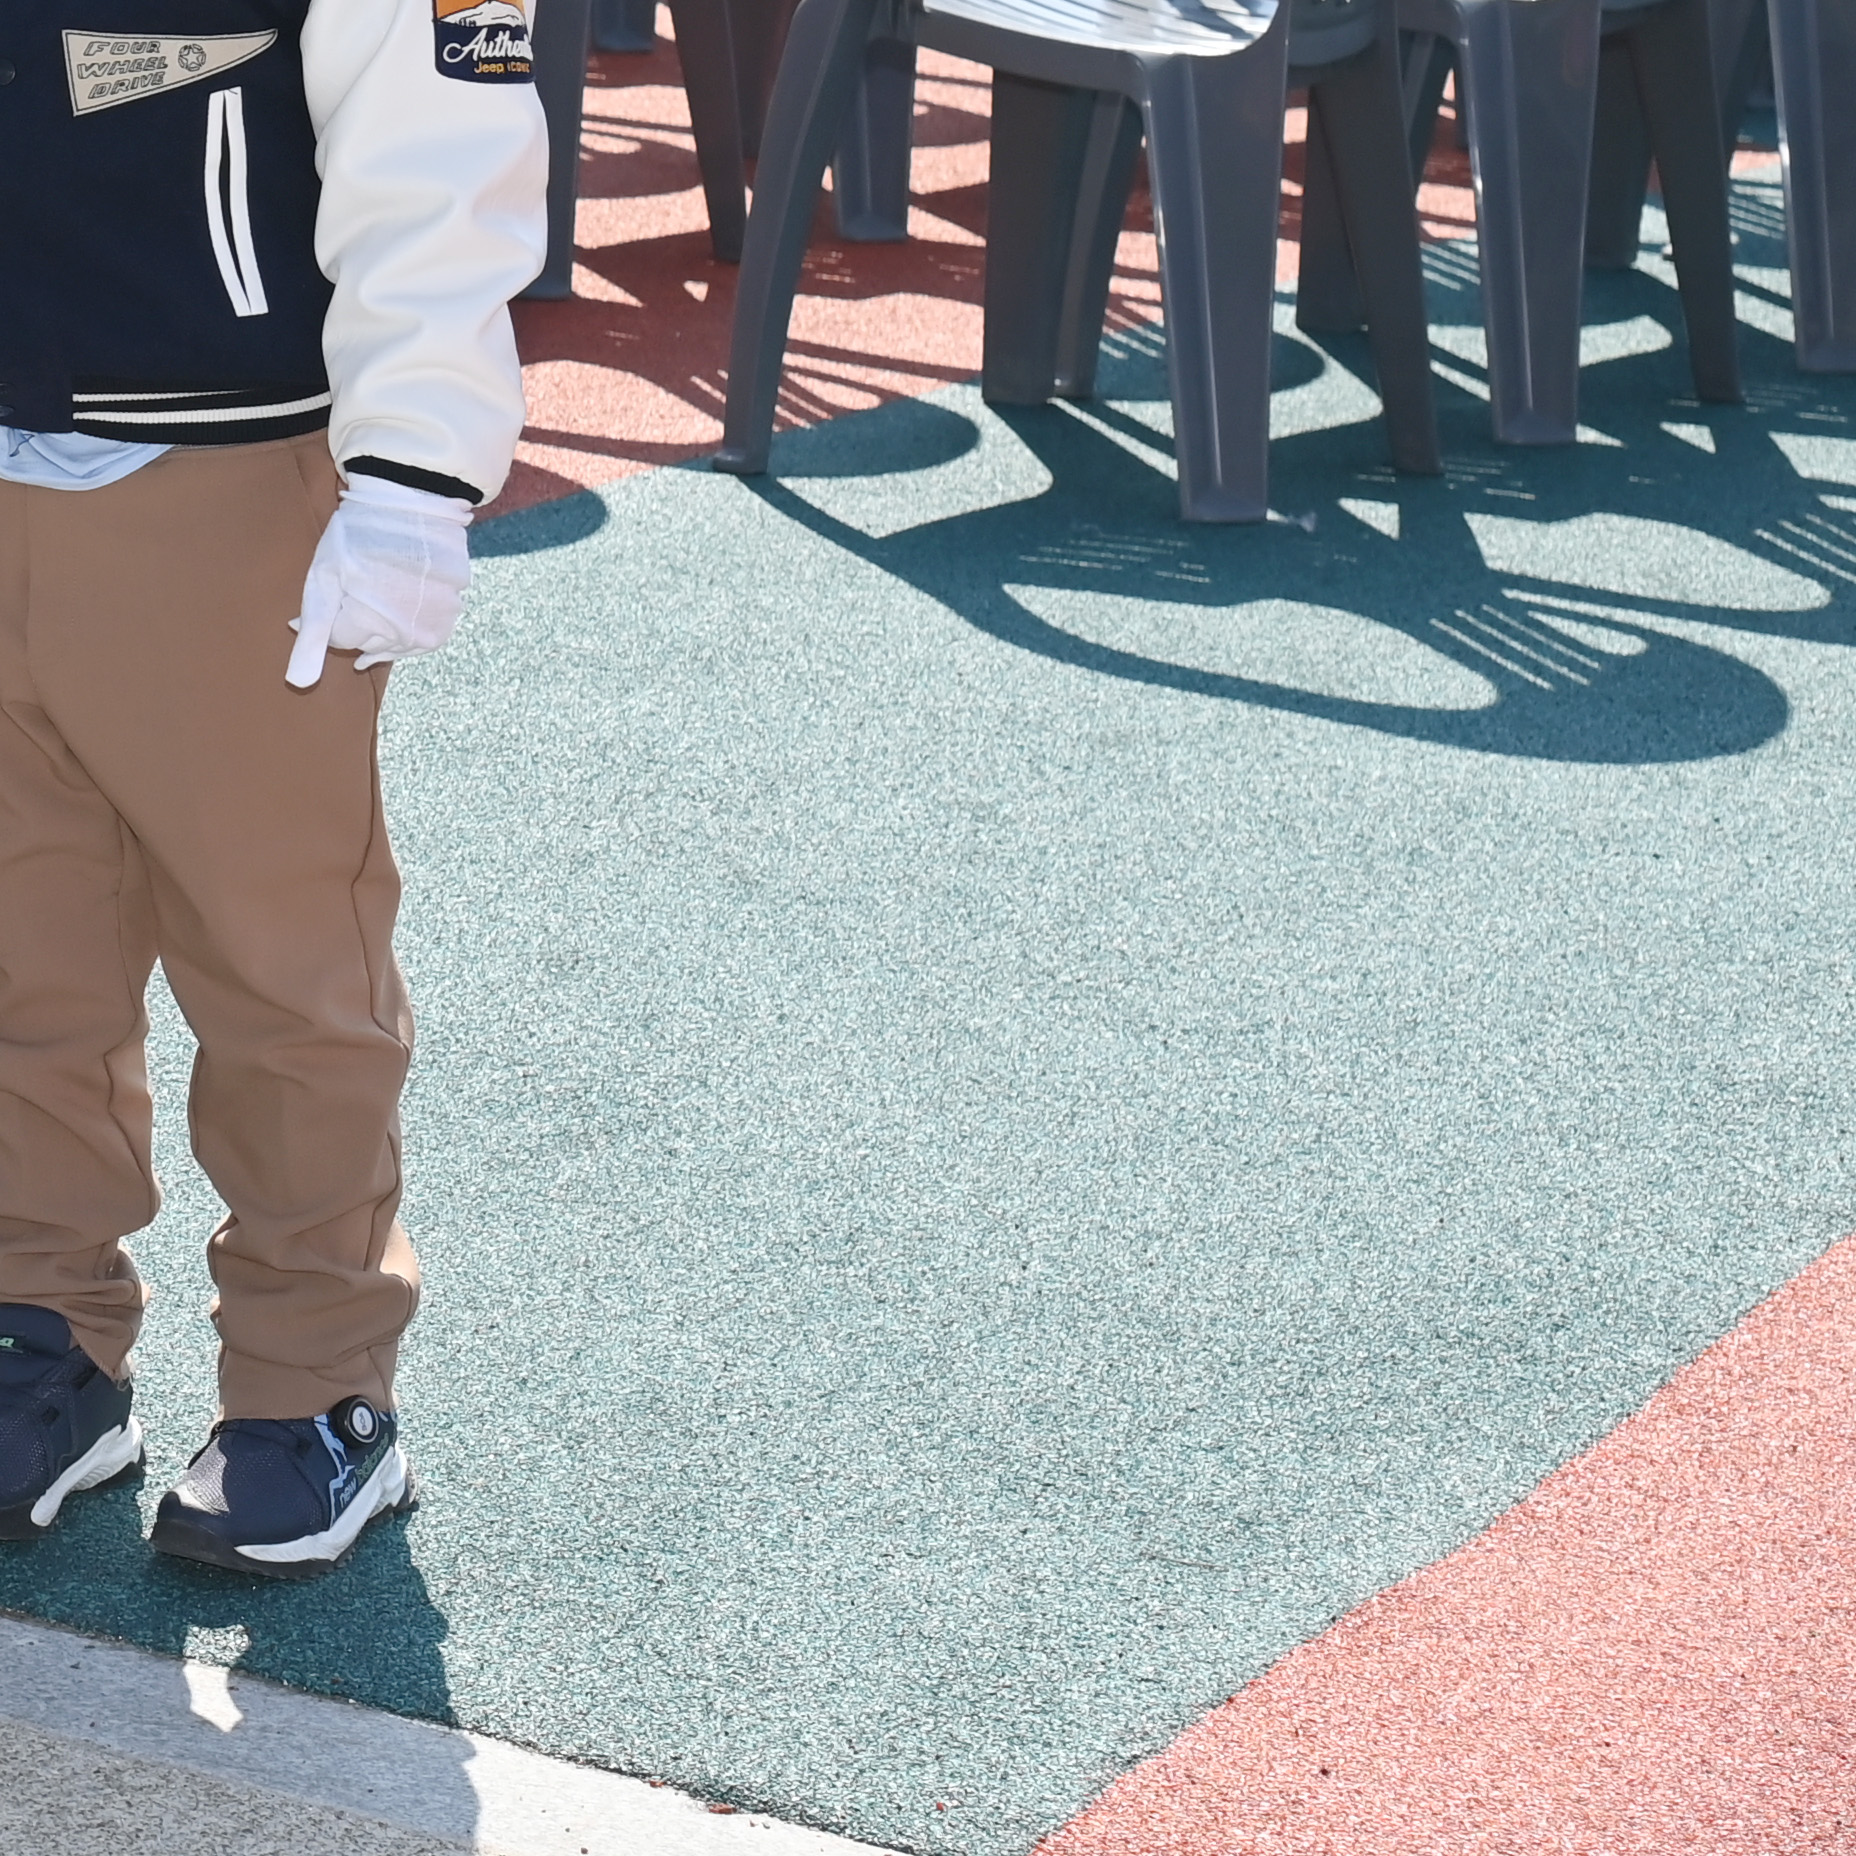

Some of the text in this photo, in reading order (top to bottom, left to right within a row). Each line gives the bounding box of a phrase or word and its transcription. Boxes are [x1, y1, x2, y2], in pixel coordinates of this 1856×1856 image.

[83, 40, 161, 57] FOUR
[77, 56, 169, 80] WHEEL
[474, 61, 505, 75] Jeep
[88, 71, 166, 100] DRIVE
